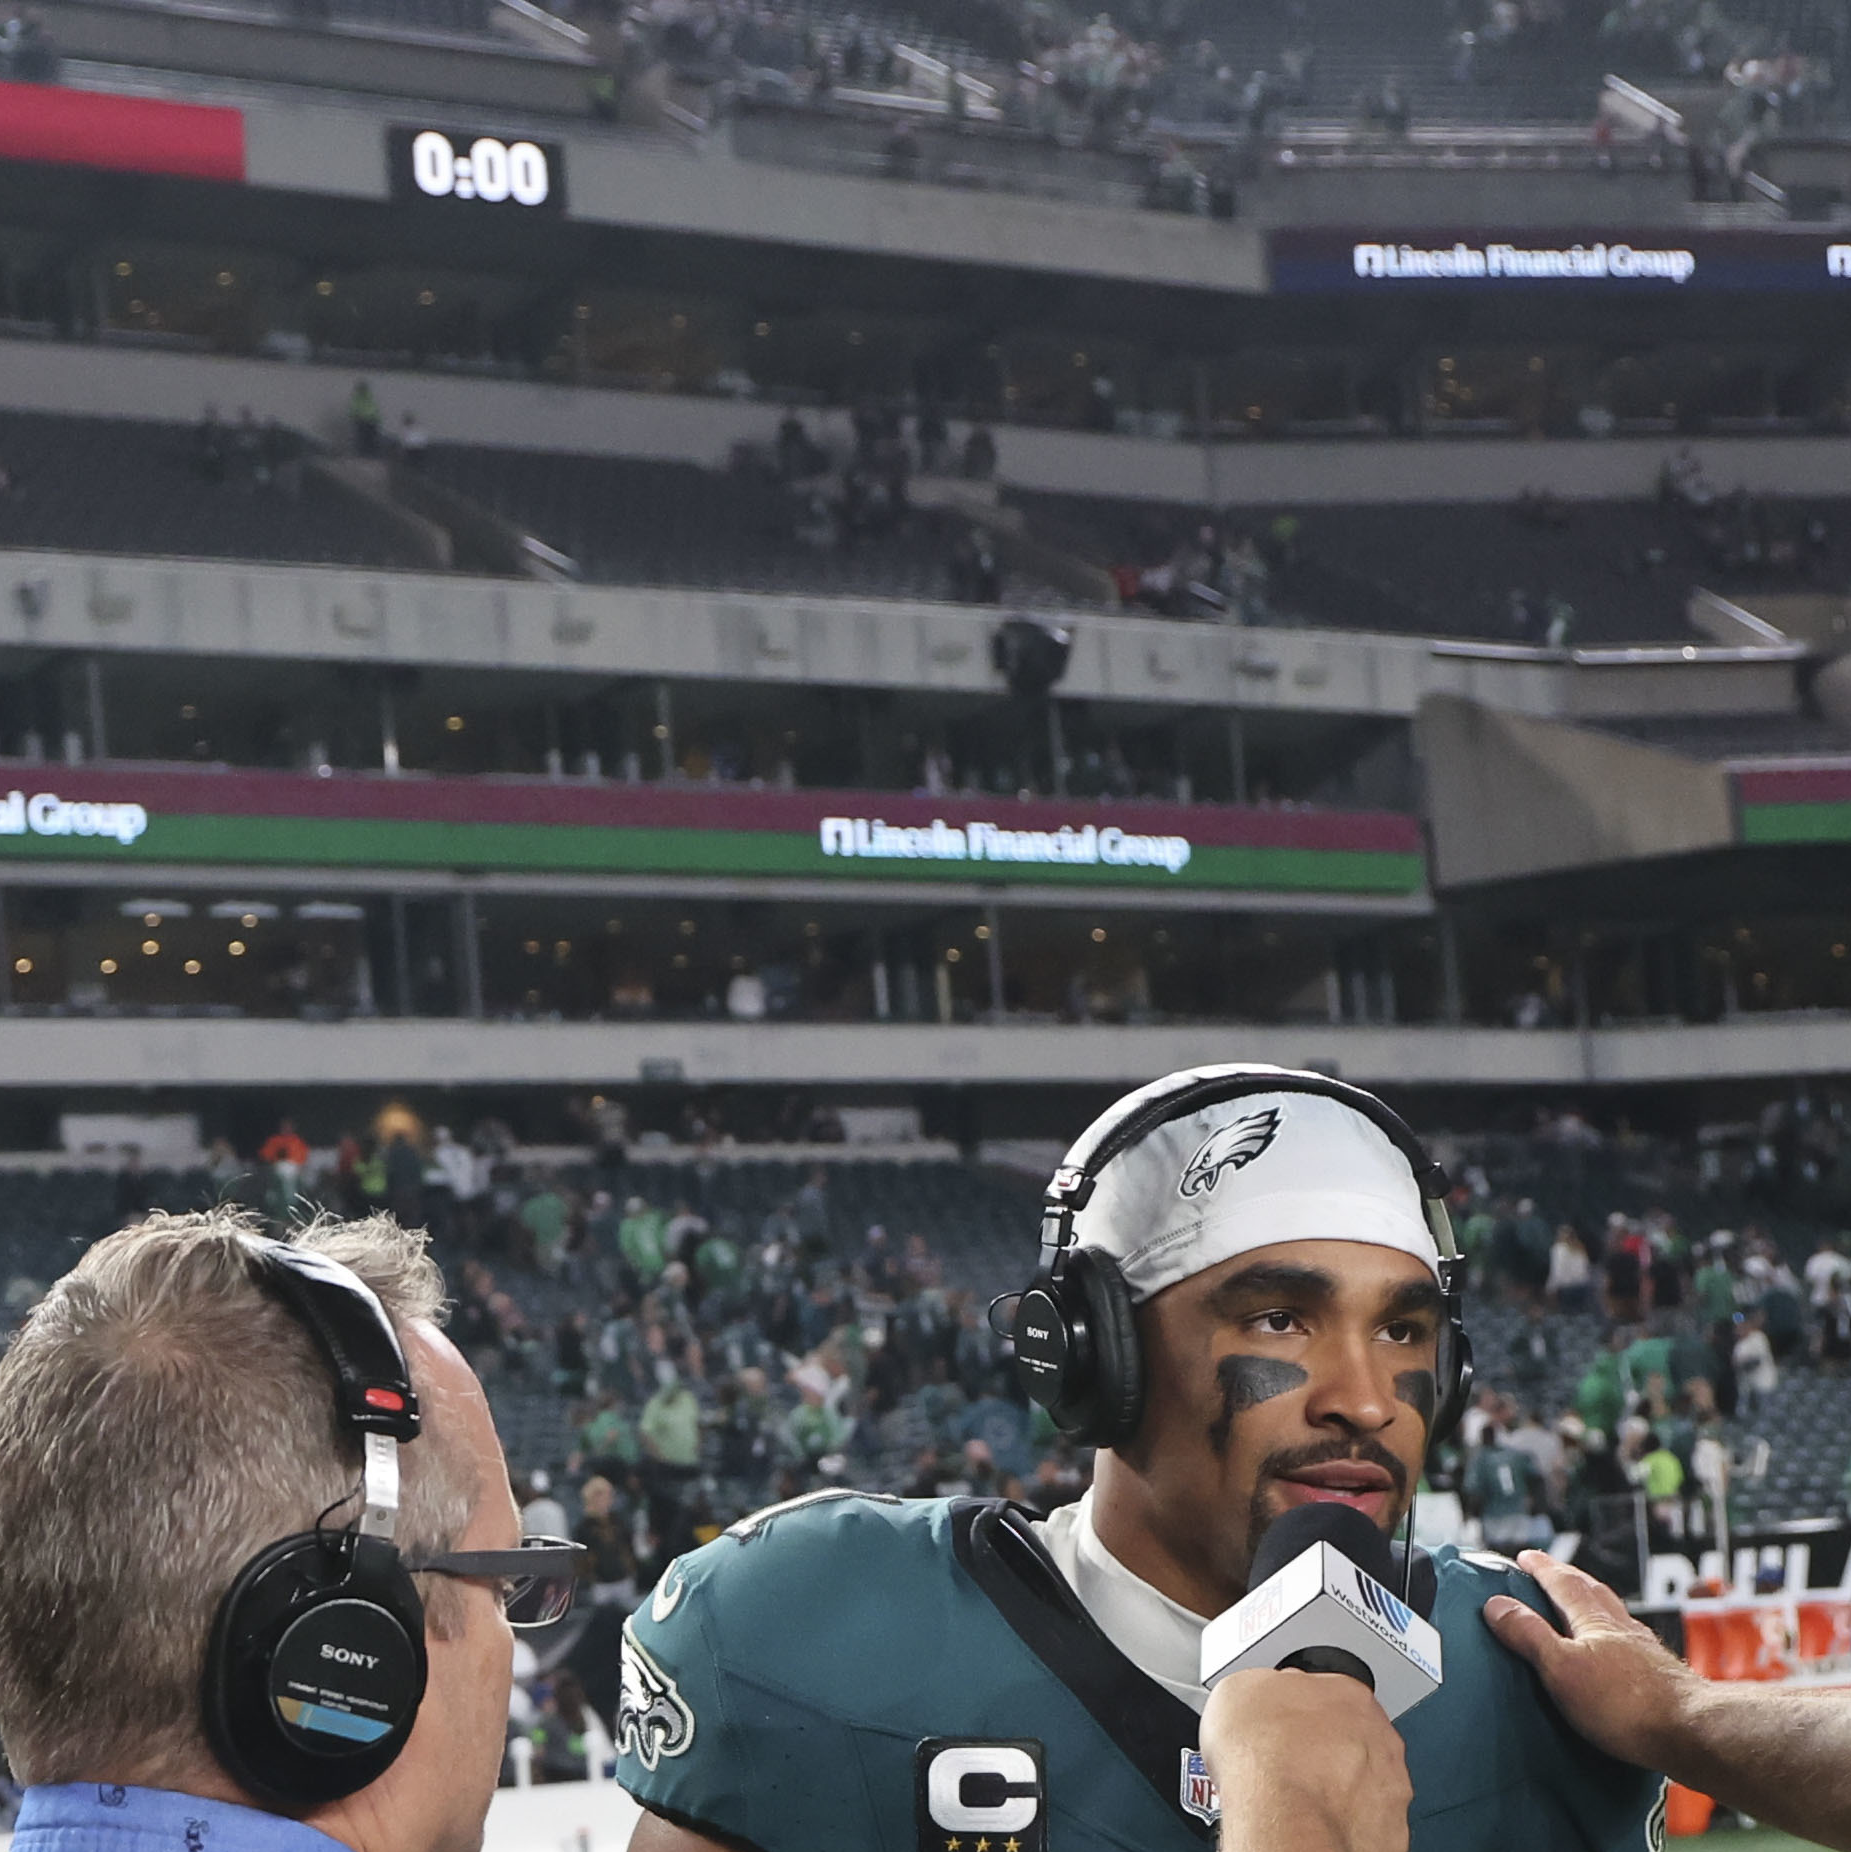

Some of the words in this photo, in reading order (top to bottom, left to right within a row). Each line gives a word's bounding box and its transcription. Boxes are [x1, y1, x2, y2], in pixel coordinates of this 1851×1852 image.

[412, 130, 549, 206] 0:00
[1384, 242, 1486, 278] Lincoln
[1487, 242, 1608, 278] Financial
[1608, 244, 1695, 284] Group
[28, 793, 148, 845] Group
[854, 818, 967, 859] Lincoln
[967, 821, 1099, 864] Financial
[1099, 826, 1191, 874] Group
[1026, 1326, 1049, 1341] SONY
[319, 1643, 381, 1670] SONY
[1329, 1582, 1408, 1652] Westwood
[1409, 1648, 1441, 1679] One
[927, 1746, 1038, 1833] C
